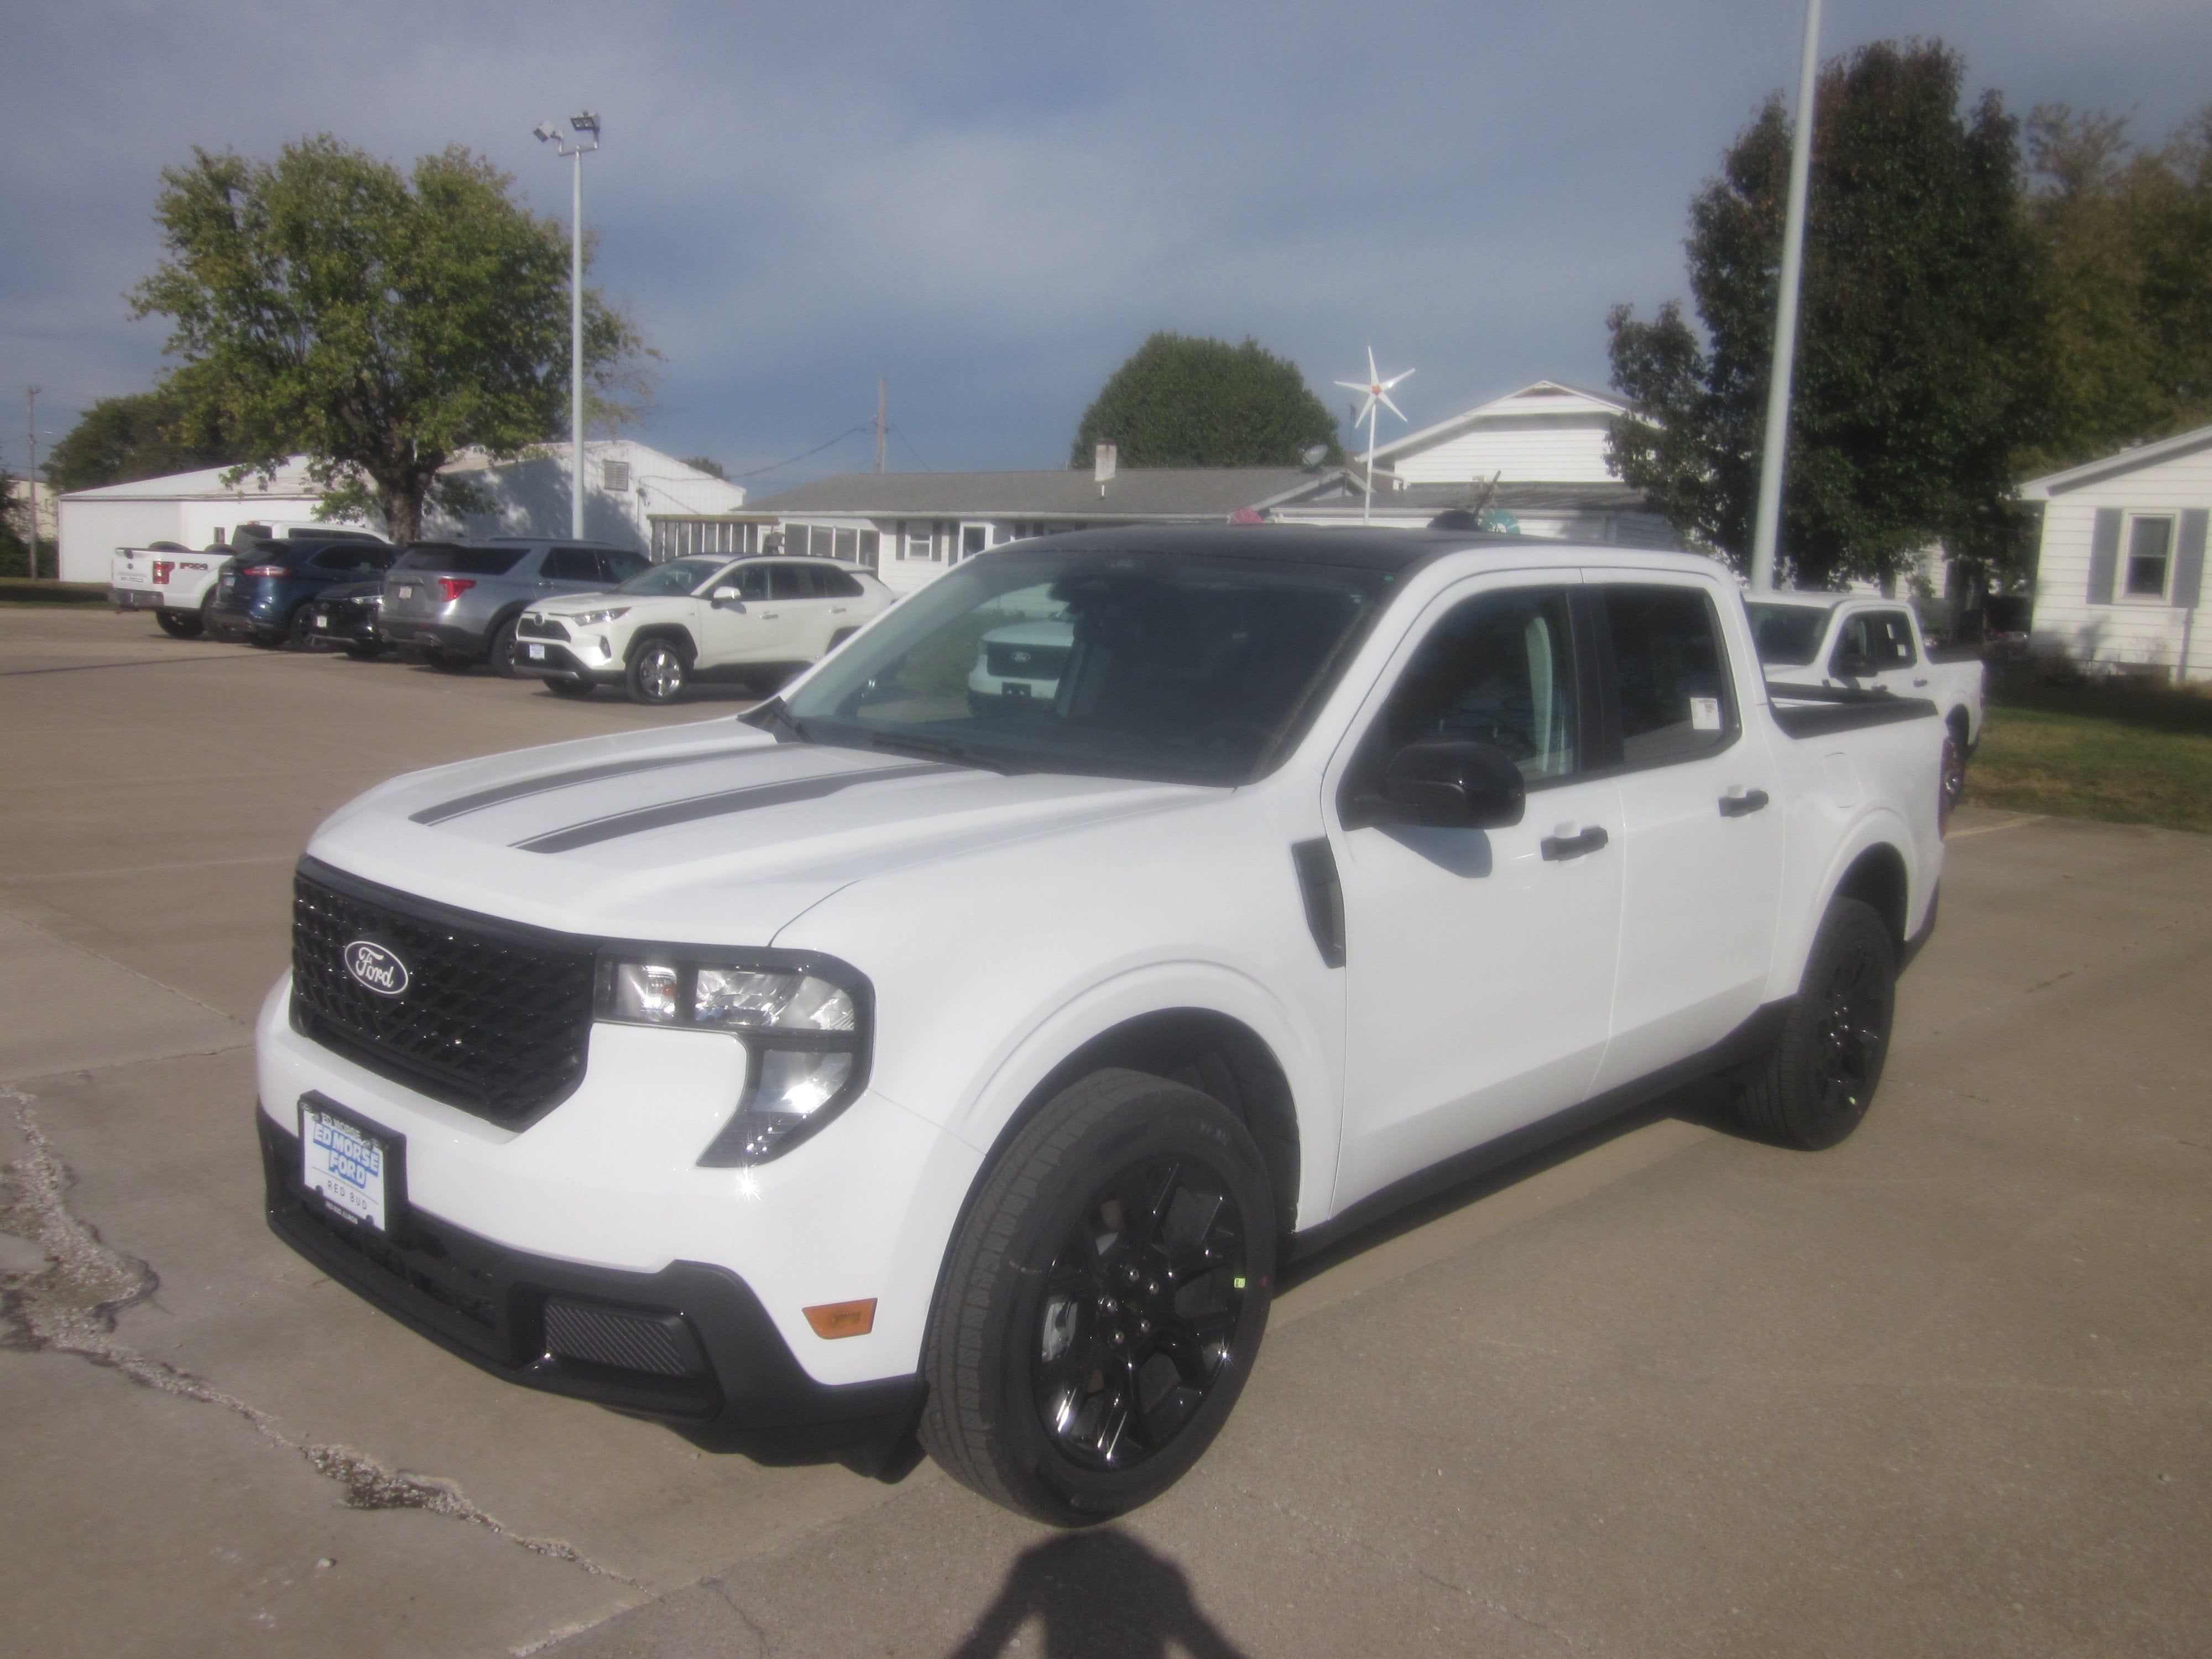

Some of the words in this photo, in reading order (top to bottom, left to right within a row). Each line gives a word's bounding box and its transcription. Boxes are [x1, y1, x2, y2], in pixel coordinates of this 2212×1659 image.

[356, 947, 394, 988] Ford
[313, 1122, 332, 1150] ED
[331, 1130, 379, 1177] MORSE
[328, 1151, 366, 1188] FORD
[328, 1180, 345, 1196] RED
[350, 1192, 367, 1209] BUD
